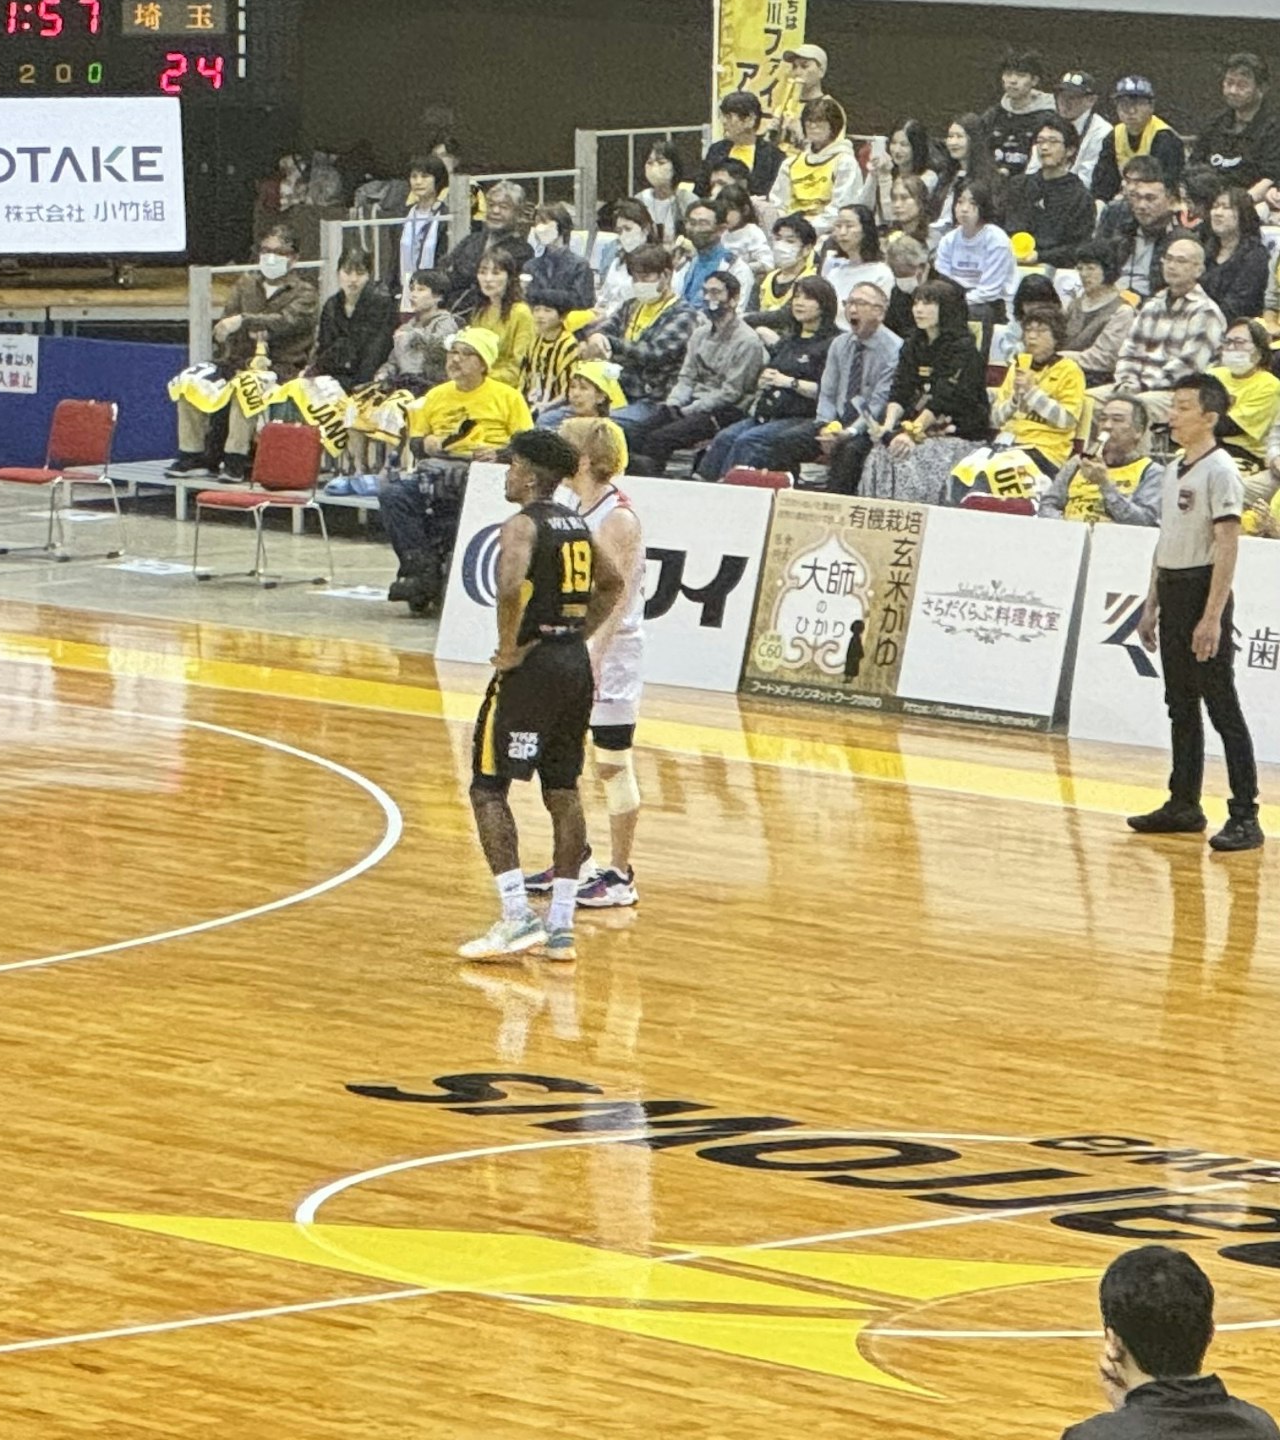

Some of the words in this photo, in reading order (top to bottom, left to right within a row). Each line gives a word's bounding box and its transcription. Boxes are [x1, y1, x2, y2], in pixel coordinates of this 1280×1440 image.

[134, 2, 216, 32] 埼玉
[158, 52, 225, 96] 24
[3, 203, 86, 223] 株式会社
[93, 200, 166, 223] 小竹組
[848, 504, 924, 535] 有機栽培
[560, 540, 593, 594] 19
[801, 557, 857, 597] 大師
[873, 537, 919, 668] 玄米がゆ
[794, 615, 846, 639] ひかり
[757, 642, 783, 660] C60
